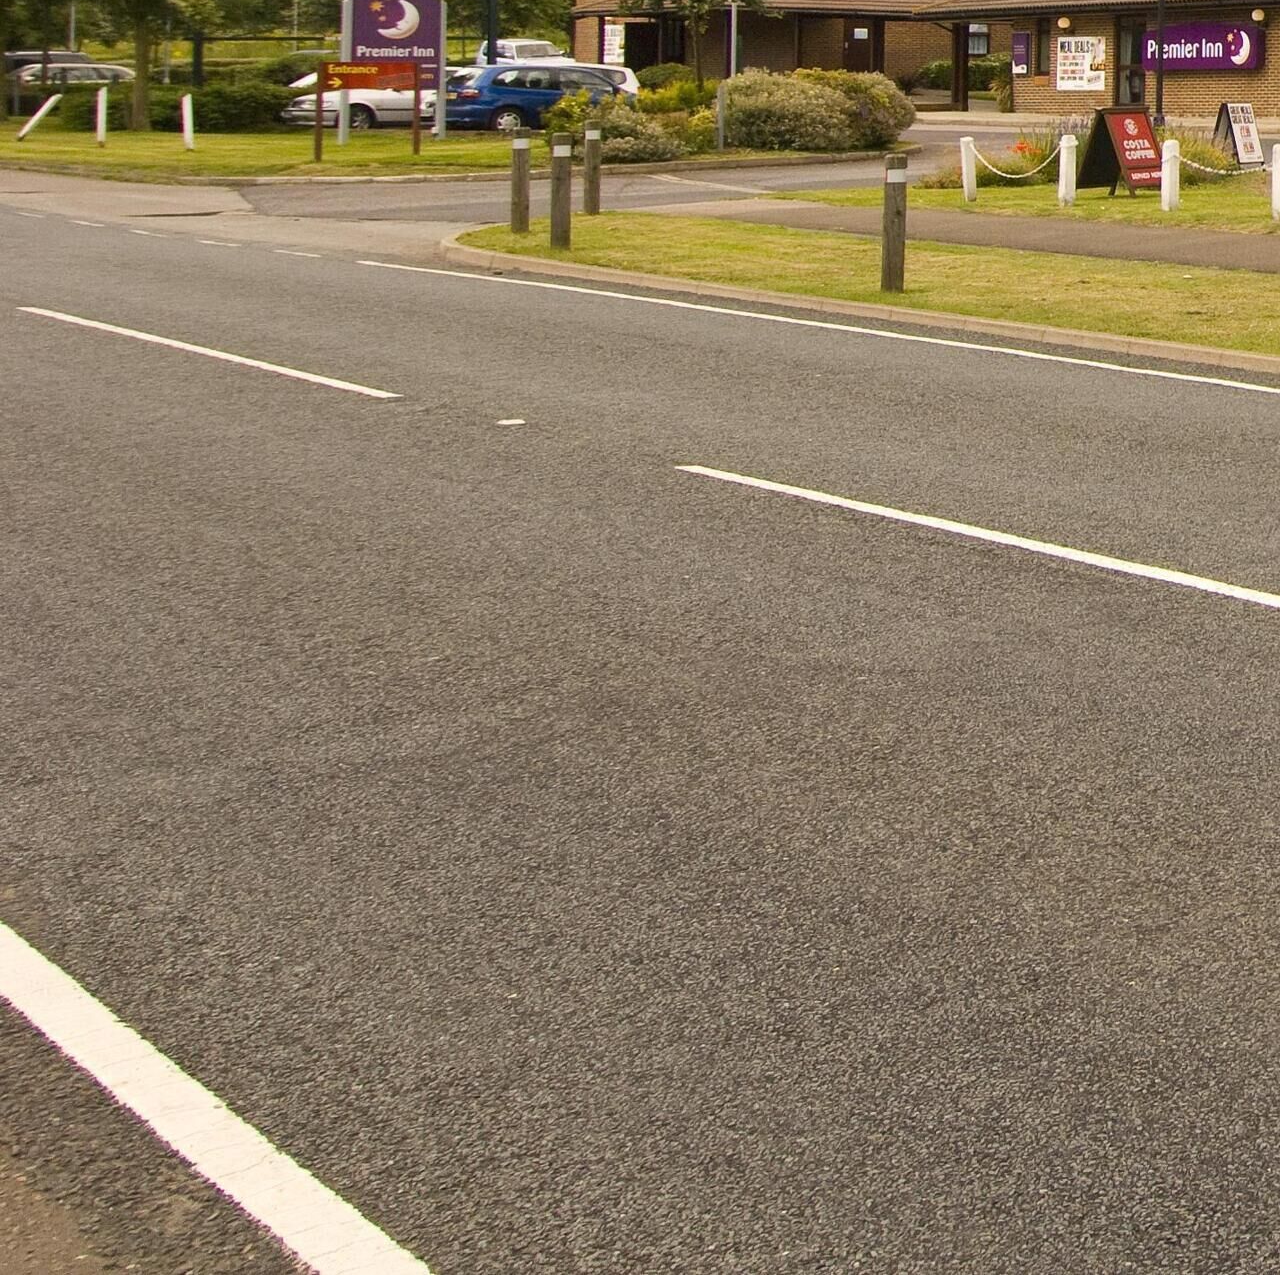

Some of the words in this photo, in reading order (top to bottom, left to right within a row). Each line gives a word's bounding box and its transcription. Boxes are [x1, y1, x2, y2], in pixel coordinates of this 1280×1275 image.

[356, 45, 412, 58] Premier
[413, 45, 435, 58] Inn
[1201, 38, 1223, 58] Inn
[327, 64, 379, 74] Entrance
[1123, 139, 1151, 150] COSTA
[1125, 149, 1156, 160] COFFEE
